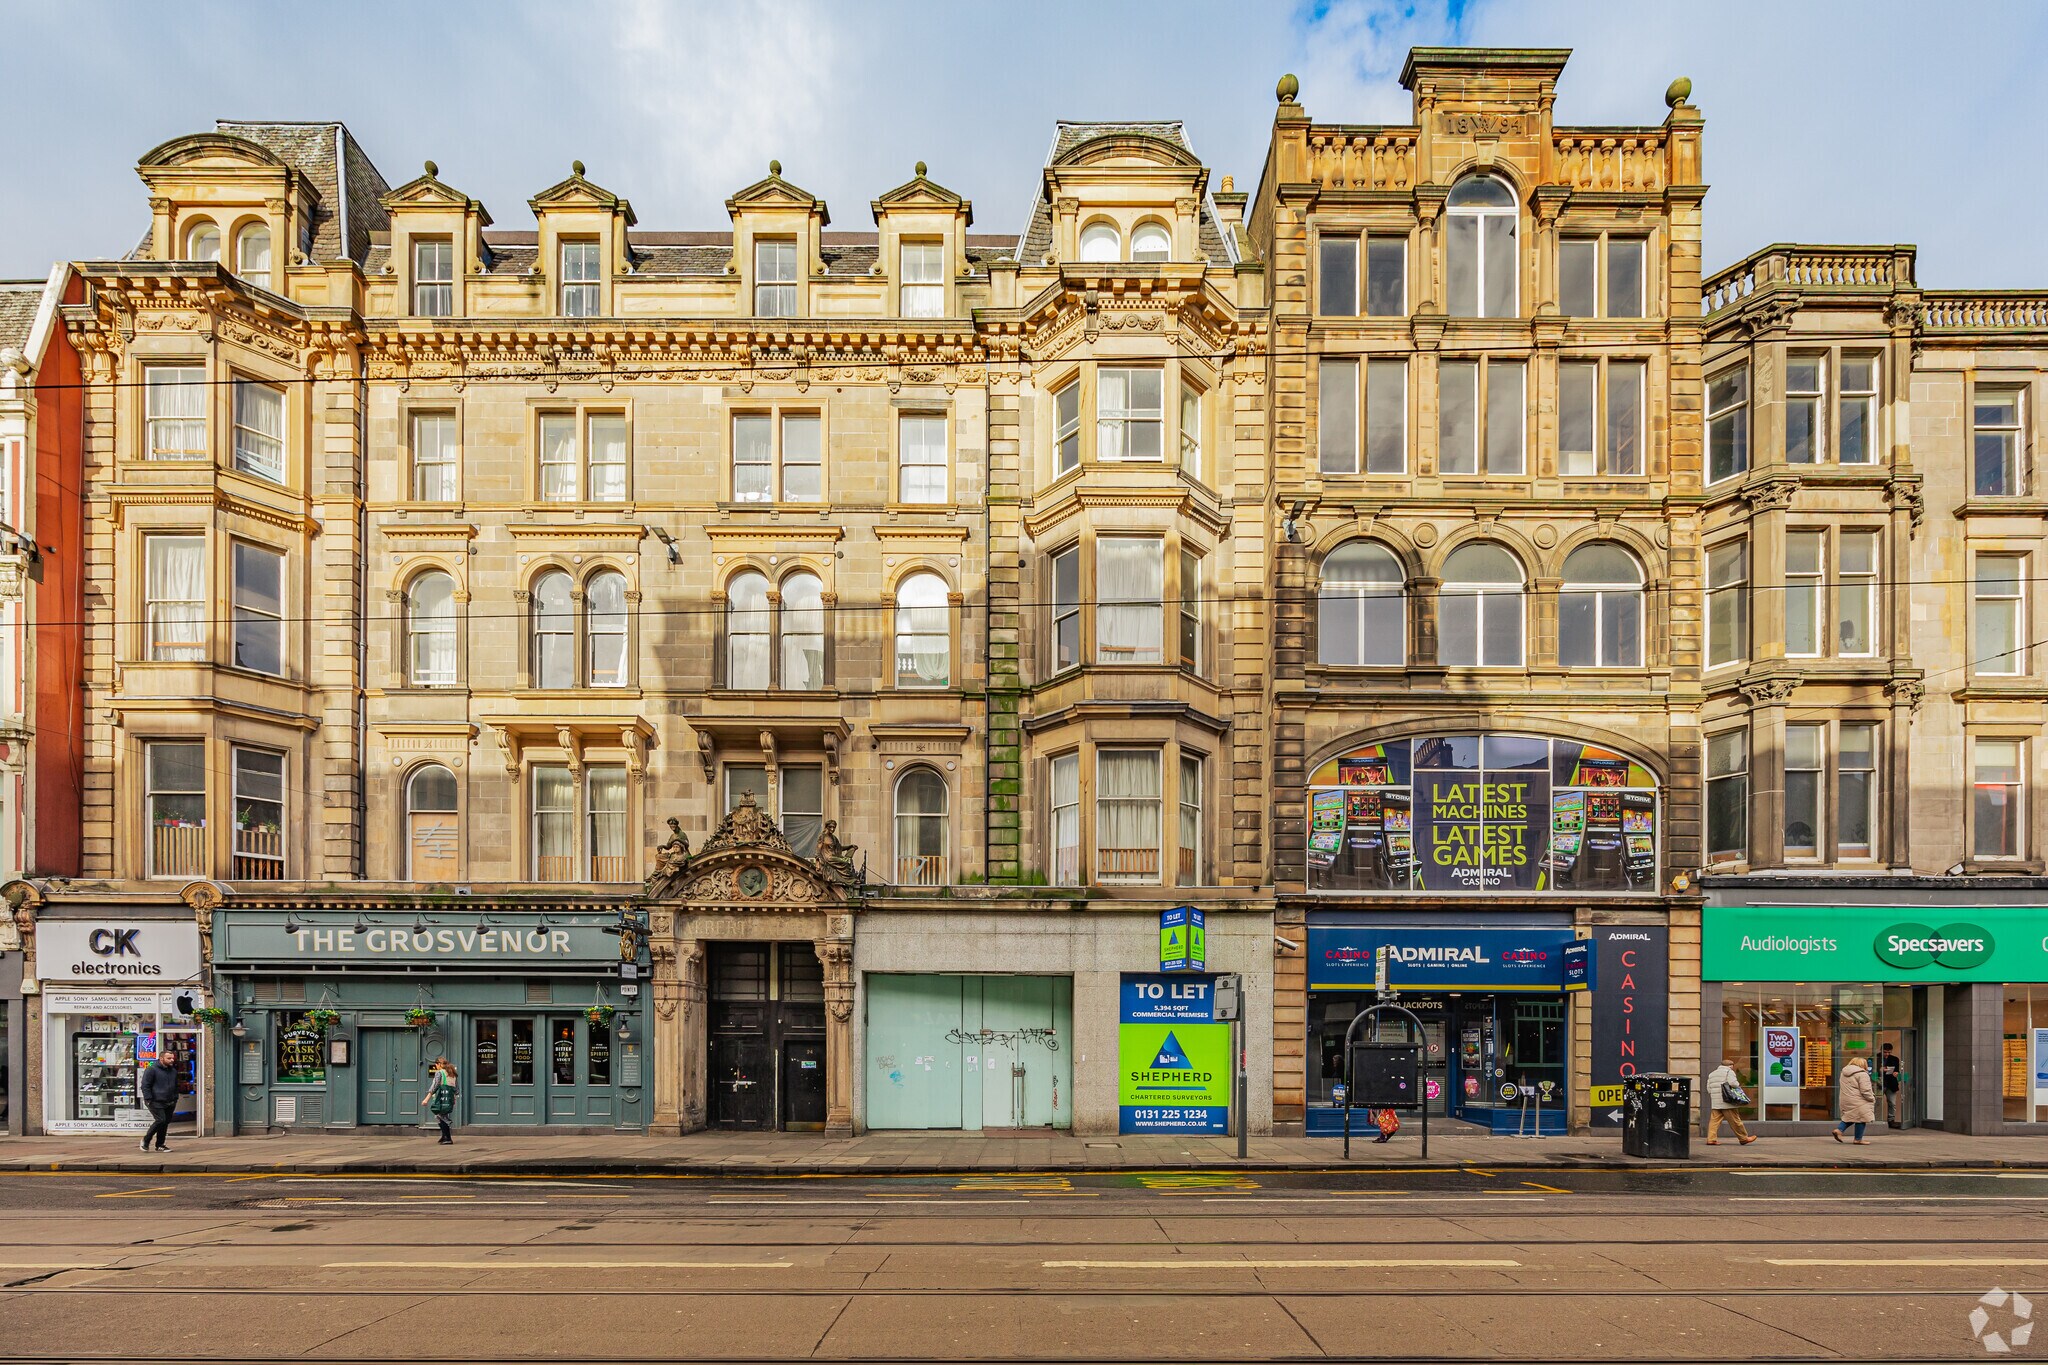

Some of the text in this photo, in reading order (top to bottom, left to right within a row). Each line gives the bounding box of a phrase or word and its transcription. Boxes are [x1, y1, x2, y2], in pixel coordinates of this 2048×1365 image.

[1432, 784, 1528, 803] LATEST
[1624, 794, 1652, 803] STORM
[1432, 804, 1528, 818] MACHINES
[1432, 825, 1528, 844] LATEST
[1432, 846, 1527, 866] GAMES
[1451, 868, 1512, 878] ADMIRAL
[1462, 878, 1500, 886] CASINO
[88, 928, 141, 957] CK
[294, 930, 571, 952] THE GROSVENOR
[1740, 935, 1837, 955] Audiologists
[1888, 935, 1984, 955] Specsavers
[1325, 950, 1370, 959] CASINO
[1390, 946, 1490, 963] ADMIRAL
[1502, 952, 1547, 960] CASINO
[72, 961, 162, 975] electronics
[1135, 984, 1208, 999] TO LET
[1620, 951, 1636, 1077] CASINO
[284, 1030, 320, 1039] PURVEYOR
[287, 1045, 315, 1053] CASK
[1769, 1039, 1792, 1048] good
[1131, 1072, 1212, 1082] SHEPHERD
[1598, 1089, 1624, 1102] OPE
[1135, 1110, 1207, 1119] 0131 225 1234
